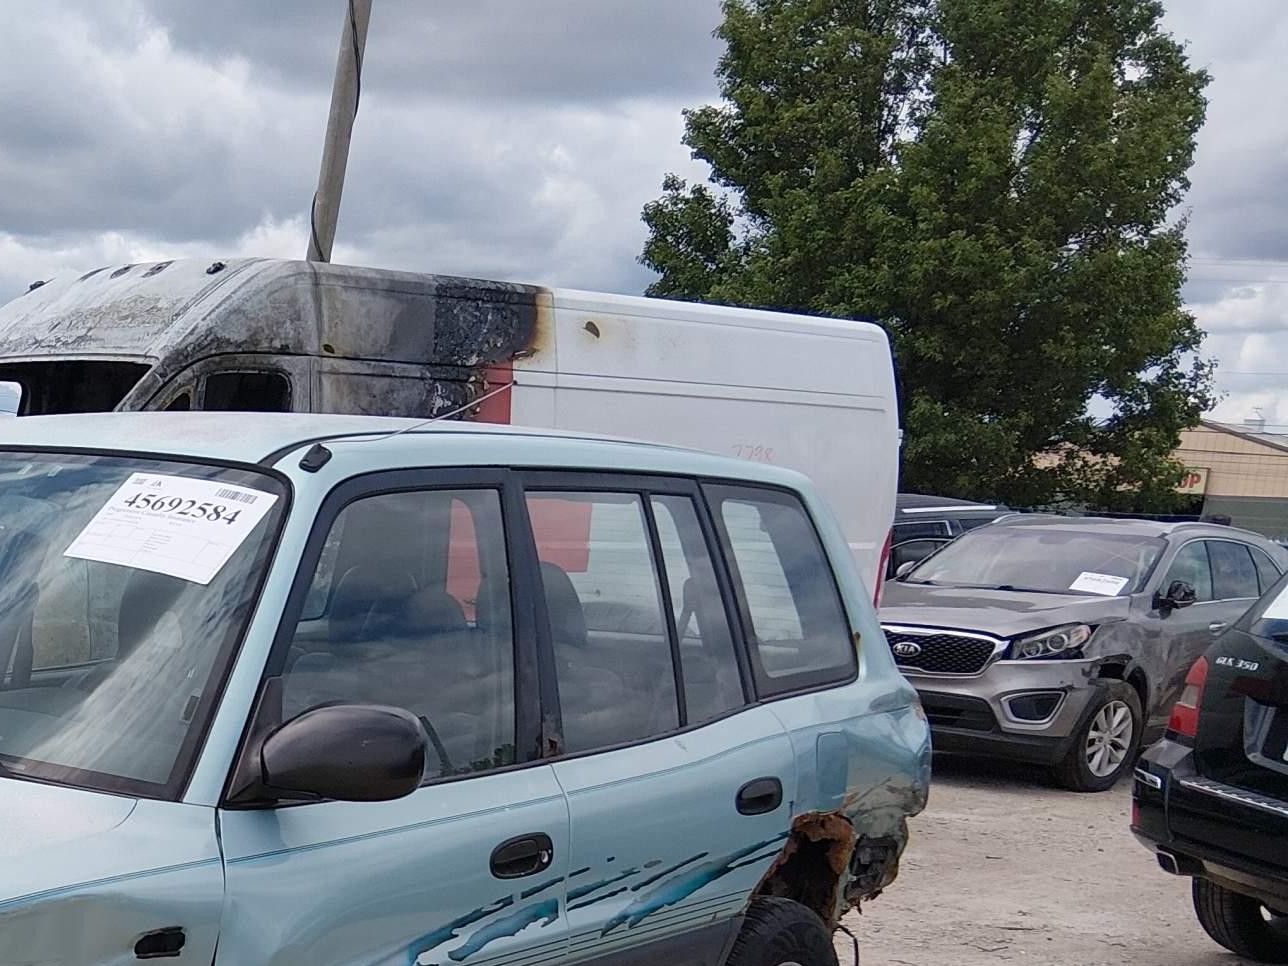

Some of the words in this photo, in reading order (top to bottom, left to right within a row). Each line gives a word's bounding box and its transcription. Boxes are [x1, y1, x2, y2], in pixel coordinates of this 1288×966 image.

[124, 492, 242, 525] 45692584
[1215, 656, 1235, 667] GLK
[1235, 659, 1260, 671] 350
